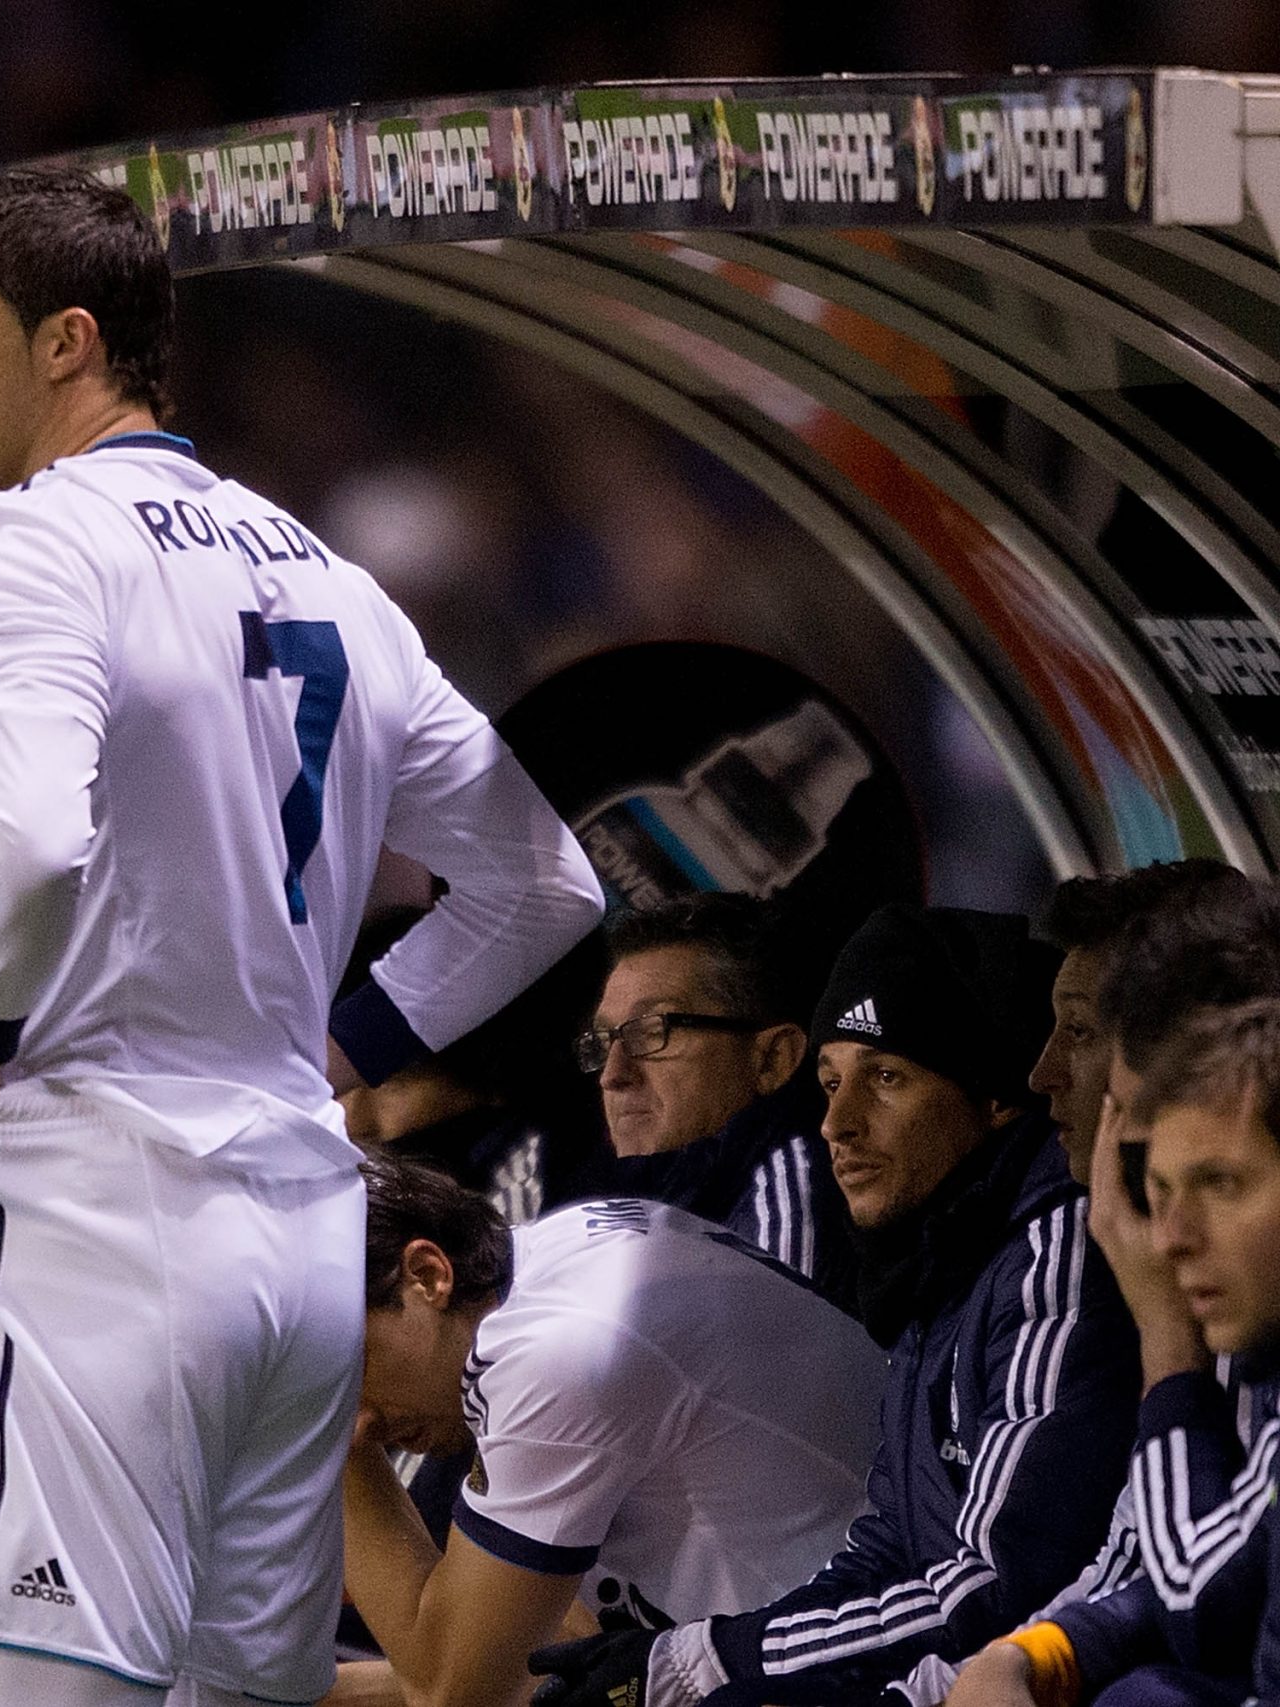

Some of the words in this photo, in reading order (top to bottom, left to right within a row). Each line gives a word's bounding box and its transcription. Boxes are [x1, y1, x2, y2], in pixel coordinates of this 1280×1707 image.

[187, 141, 311, 235] POWERADE
[366, 127, 497, 218] POWERADE
[563, 113, 698, 206] POWERADE
[756, 113, 897, 203] POWERADE
[960, 107, 1105, 201] POWERADE
[238, 611, 350, 926] 7
[836, 1017, 883, 1036] adidas
[11, 1583, 76, 1608] adidas
